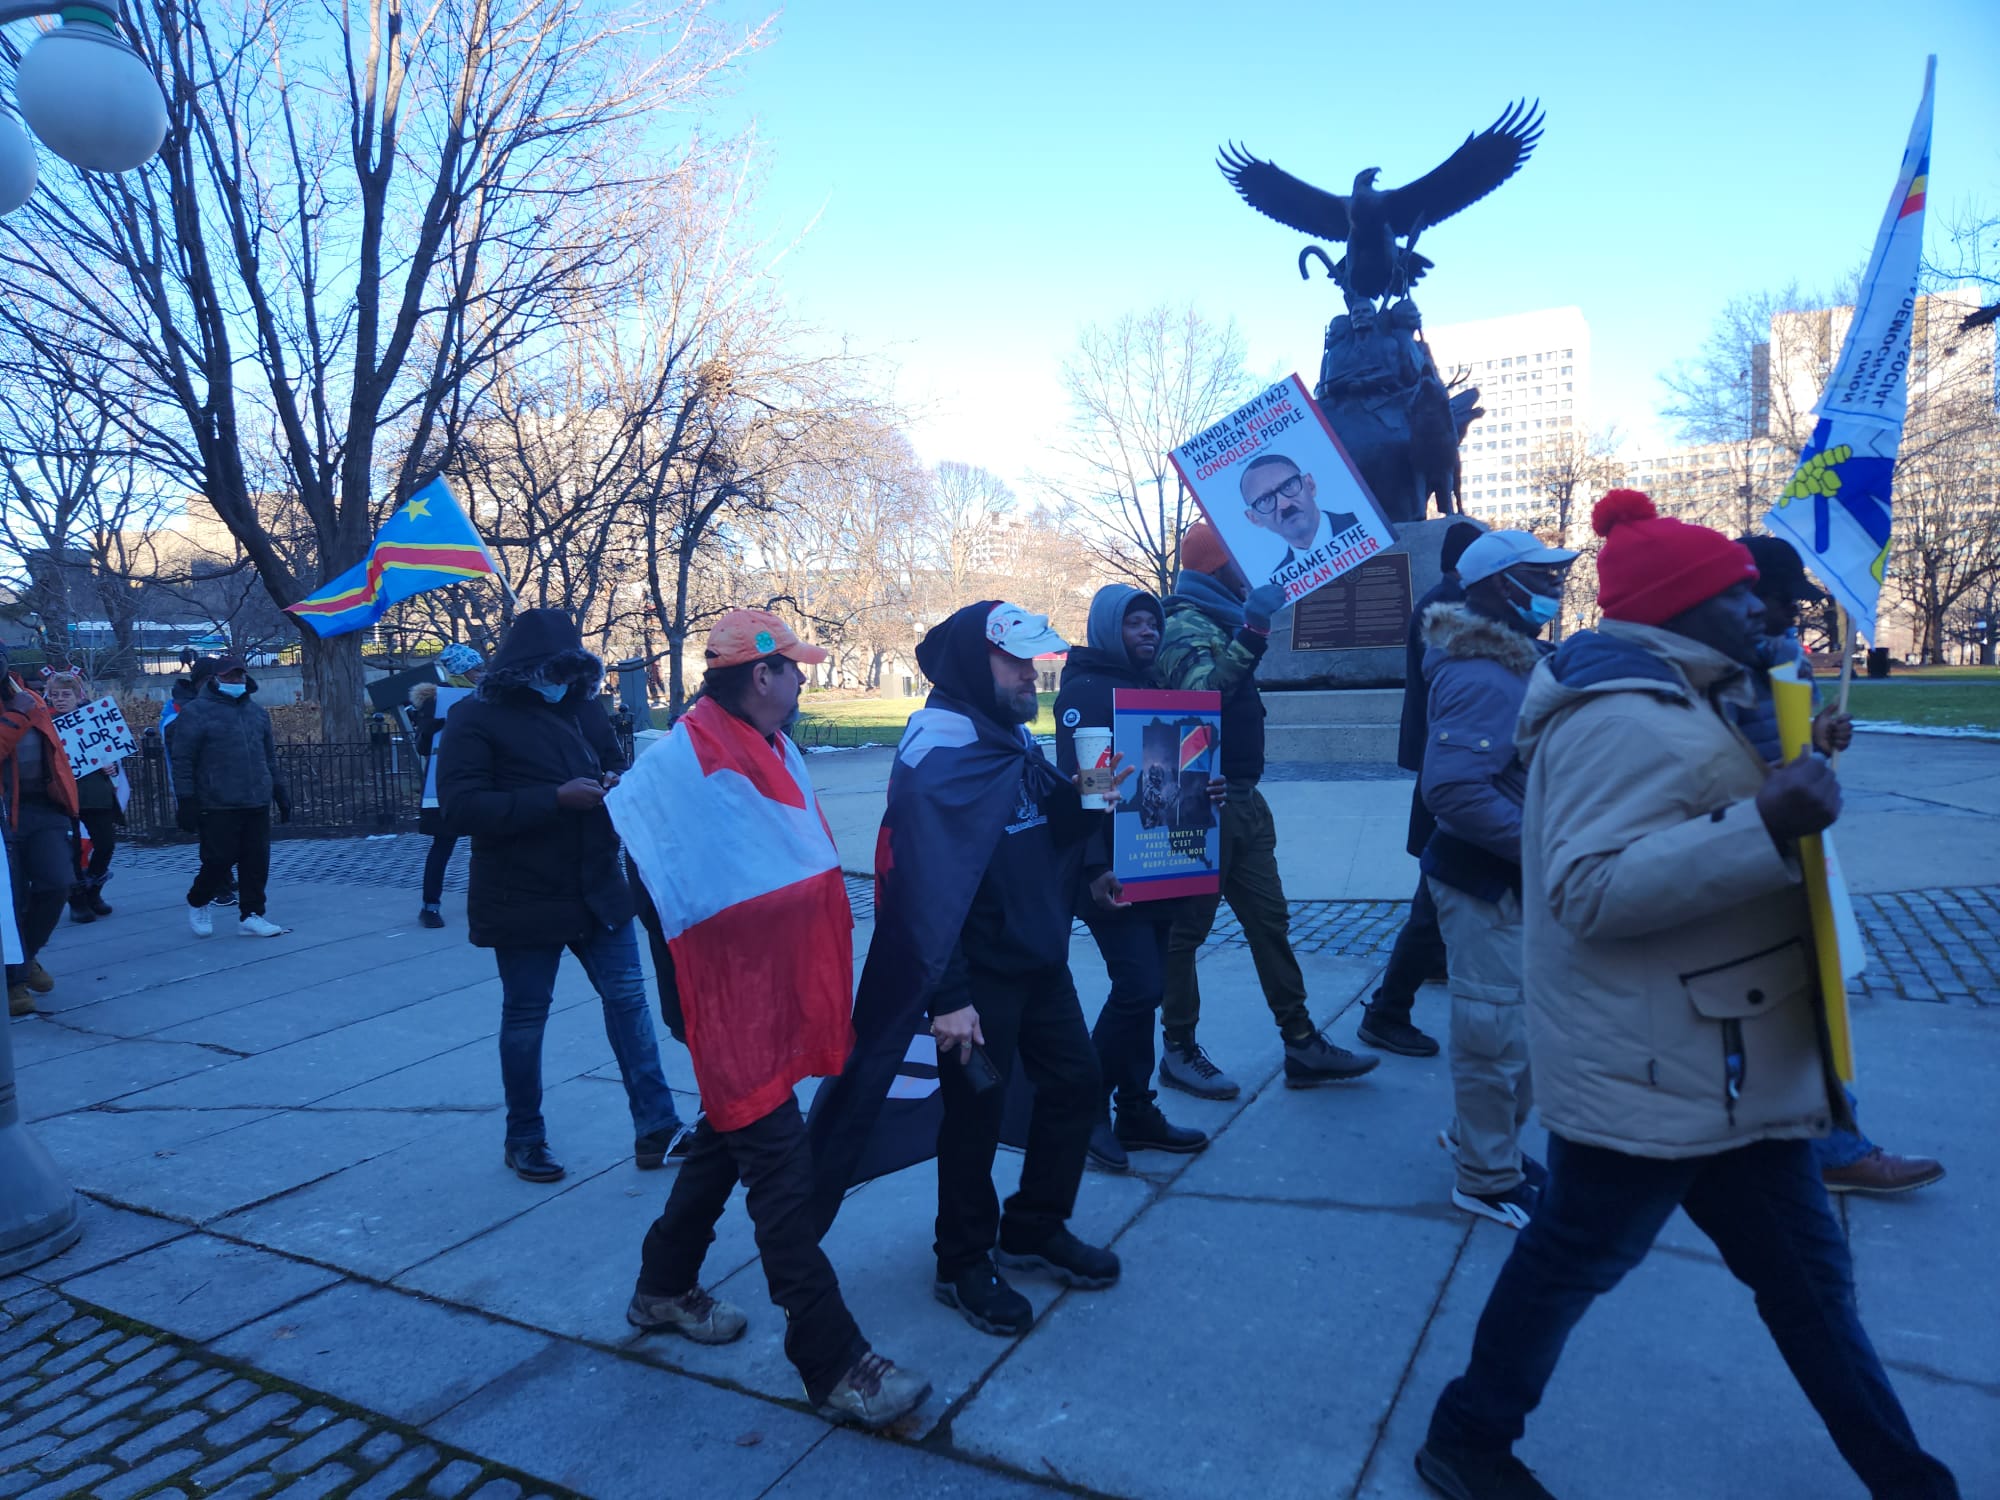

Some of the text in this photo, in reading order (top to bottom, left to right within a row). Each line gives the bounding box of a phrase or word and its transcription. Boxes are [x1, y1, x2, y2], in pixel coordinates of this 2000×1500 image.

[1181, 422, 1231, 458] RWANDA
[1233, 398, 1264, 427] ARMY
[1265, 384, 1289, 406] M23
[1192, 445, 1218, 467] HAS
[1216, 427, 1248, 452] BEEN
[1246, 399, 1292, 434] KILLING
[1196, 434, 1262, 481] CONGOLESE
[1260, 407, 1304, 441] PEOPLE
[1269, 524, 1368, 587] KAGAME IS THE
[1283, 536, 1380, 601] FRICAN HITLER
[53, 707, 122, 733] REE THE
[1167, 849, 1176, 857] OU
[1188, 847, 1207, 855] MORT
[1173, 839, 1191, 847] C'EST
[1196, 829, 1204, 837] TE
